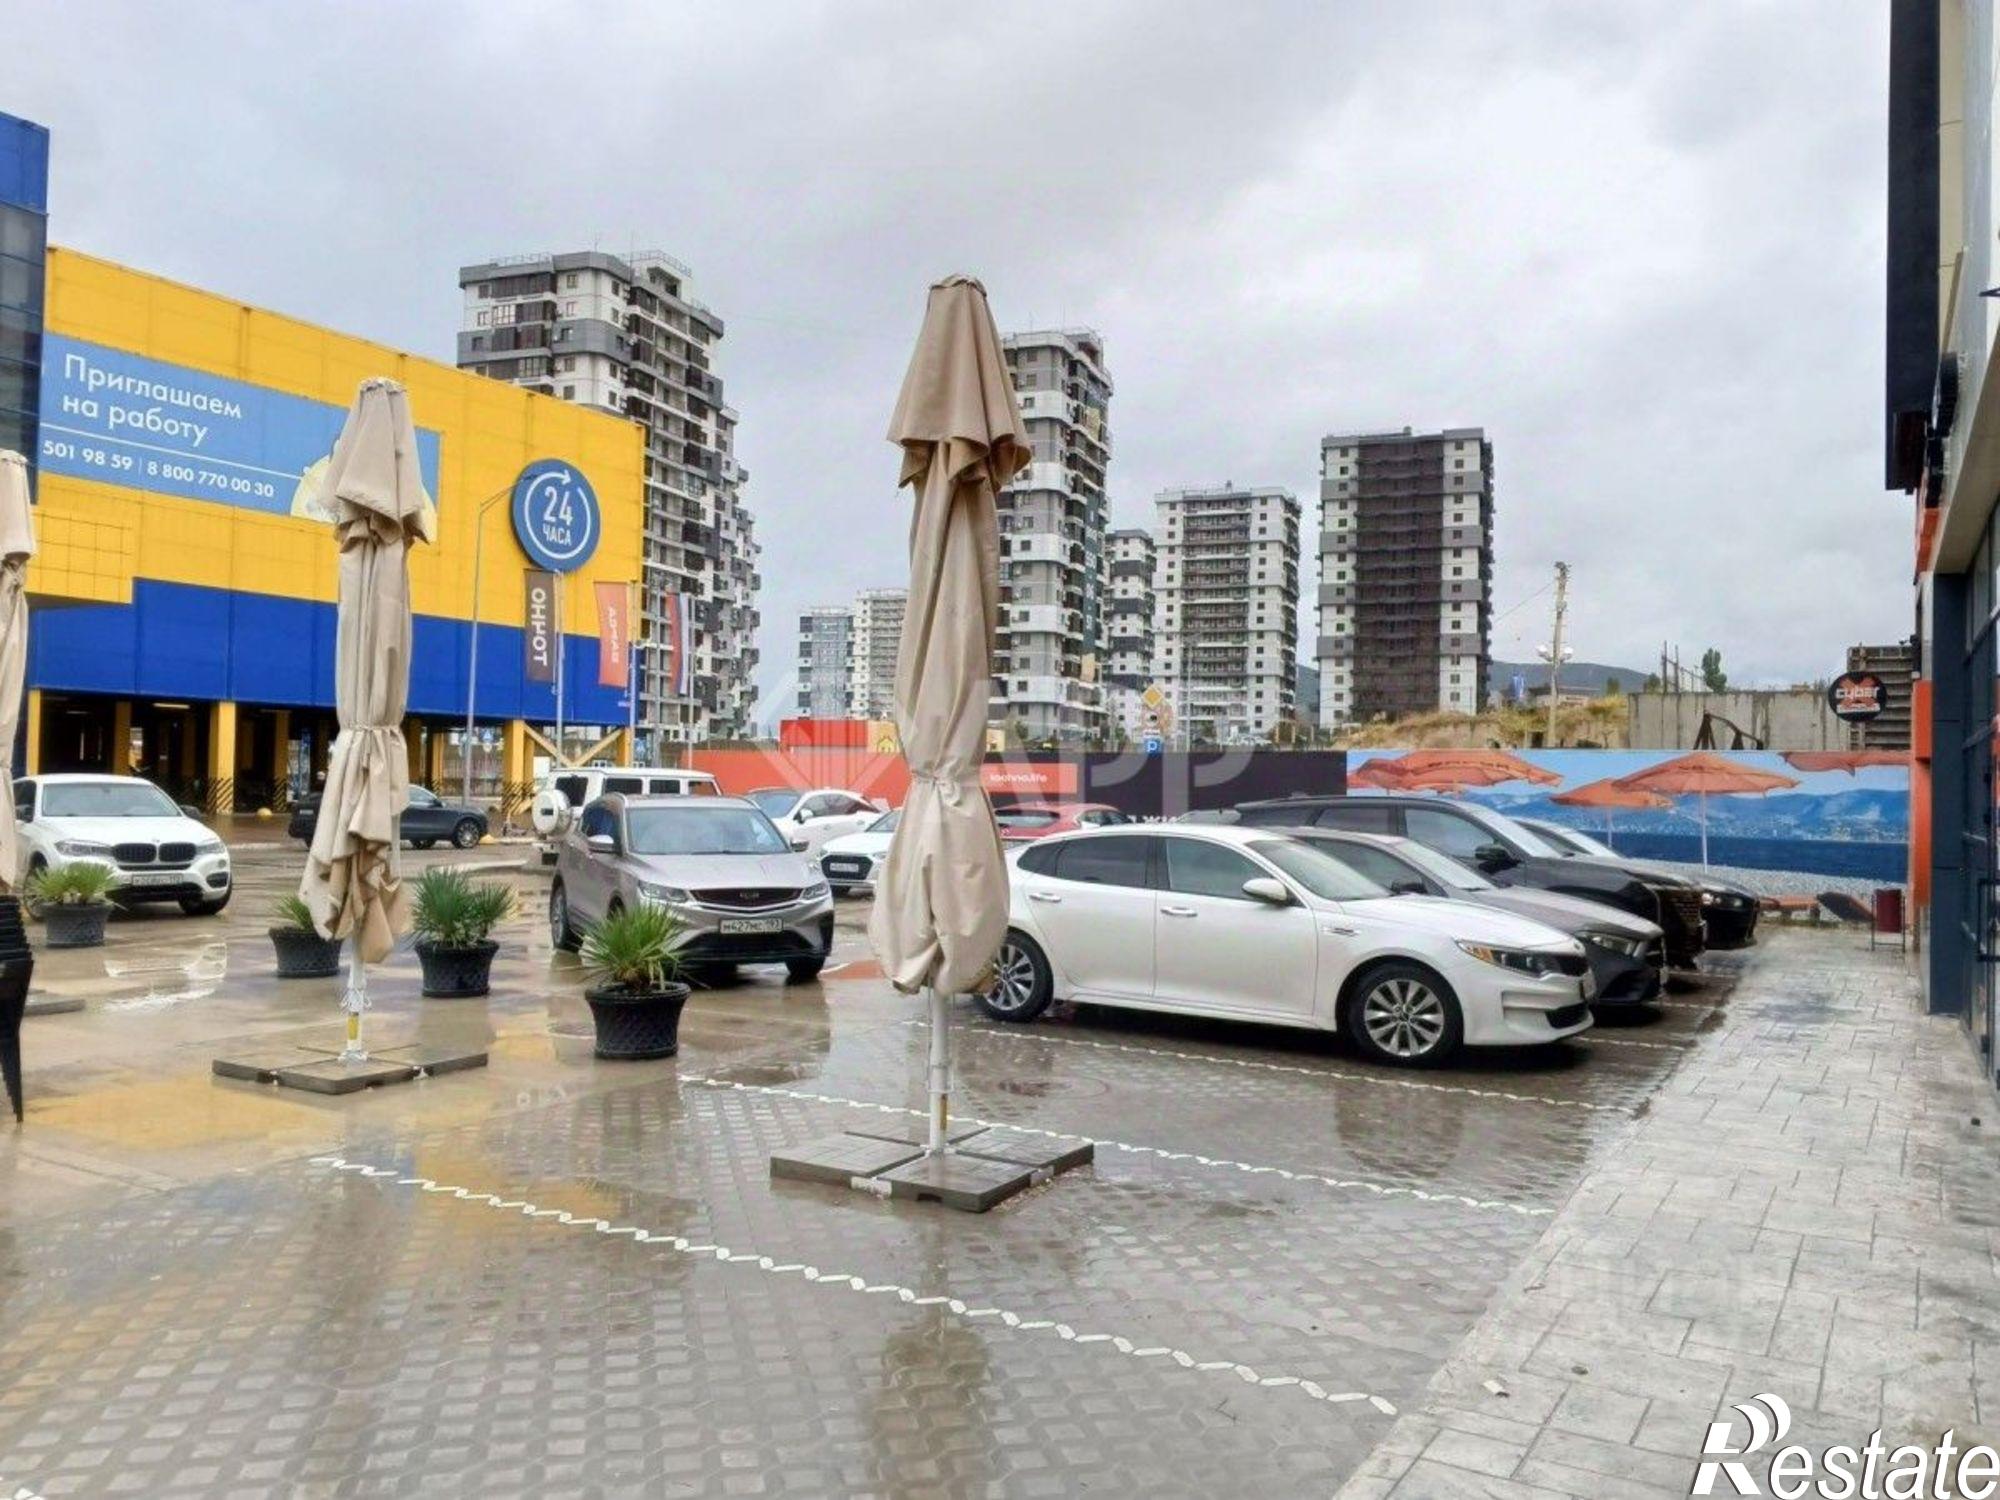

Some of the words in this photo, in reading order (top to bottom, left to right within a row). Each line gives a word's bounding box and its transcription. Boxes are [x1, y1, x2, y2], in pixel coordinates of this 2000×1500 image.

[65, 353, 242, 419] Приглашаем
[63, 395, 98, 418] на
[109, 405, 208, 447] работу
[43, 440, 75, 459] 501
[82, 447, 106, 466] 98
[110, 453, 133, 471] 59
[147, 460, 157, 476] 8
[162, 462, 194, 482] 800
[198, 469, 228, 488] 770
[230, 478, 252, 494] 00
[254, 482, 275, 498] 30
[544, 486, 573, 526] 24
[542, 525, 572, 546] ЧАСА
